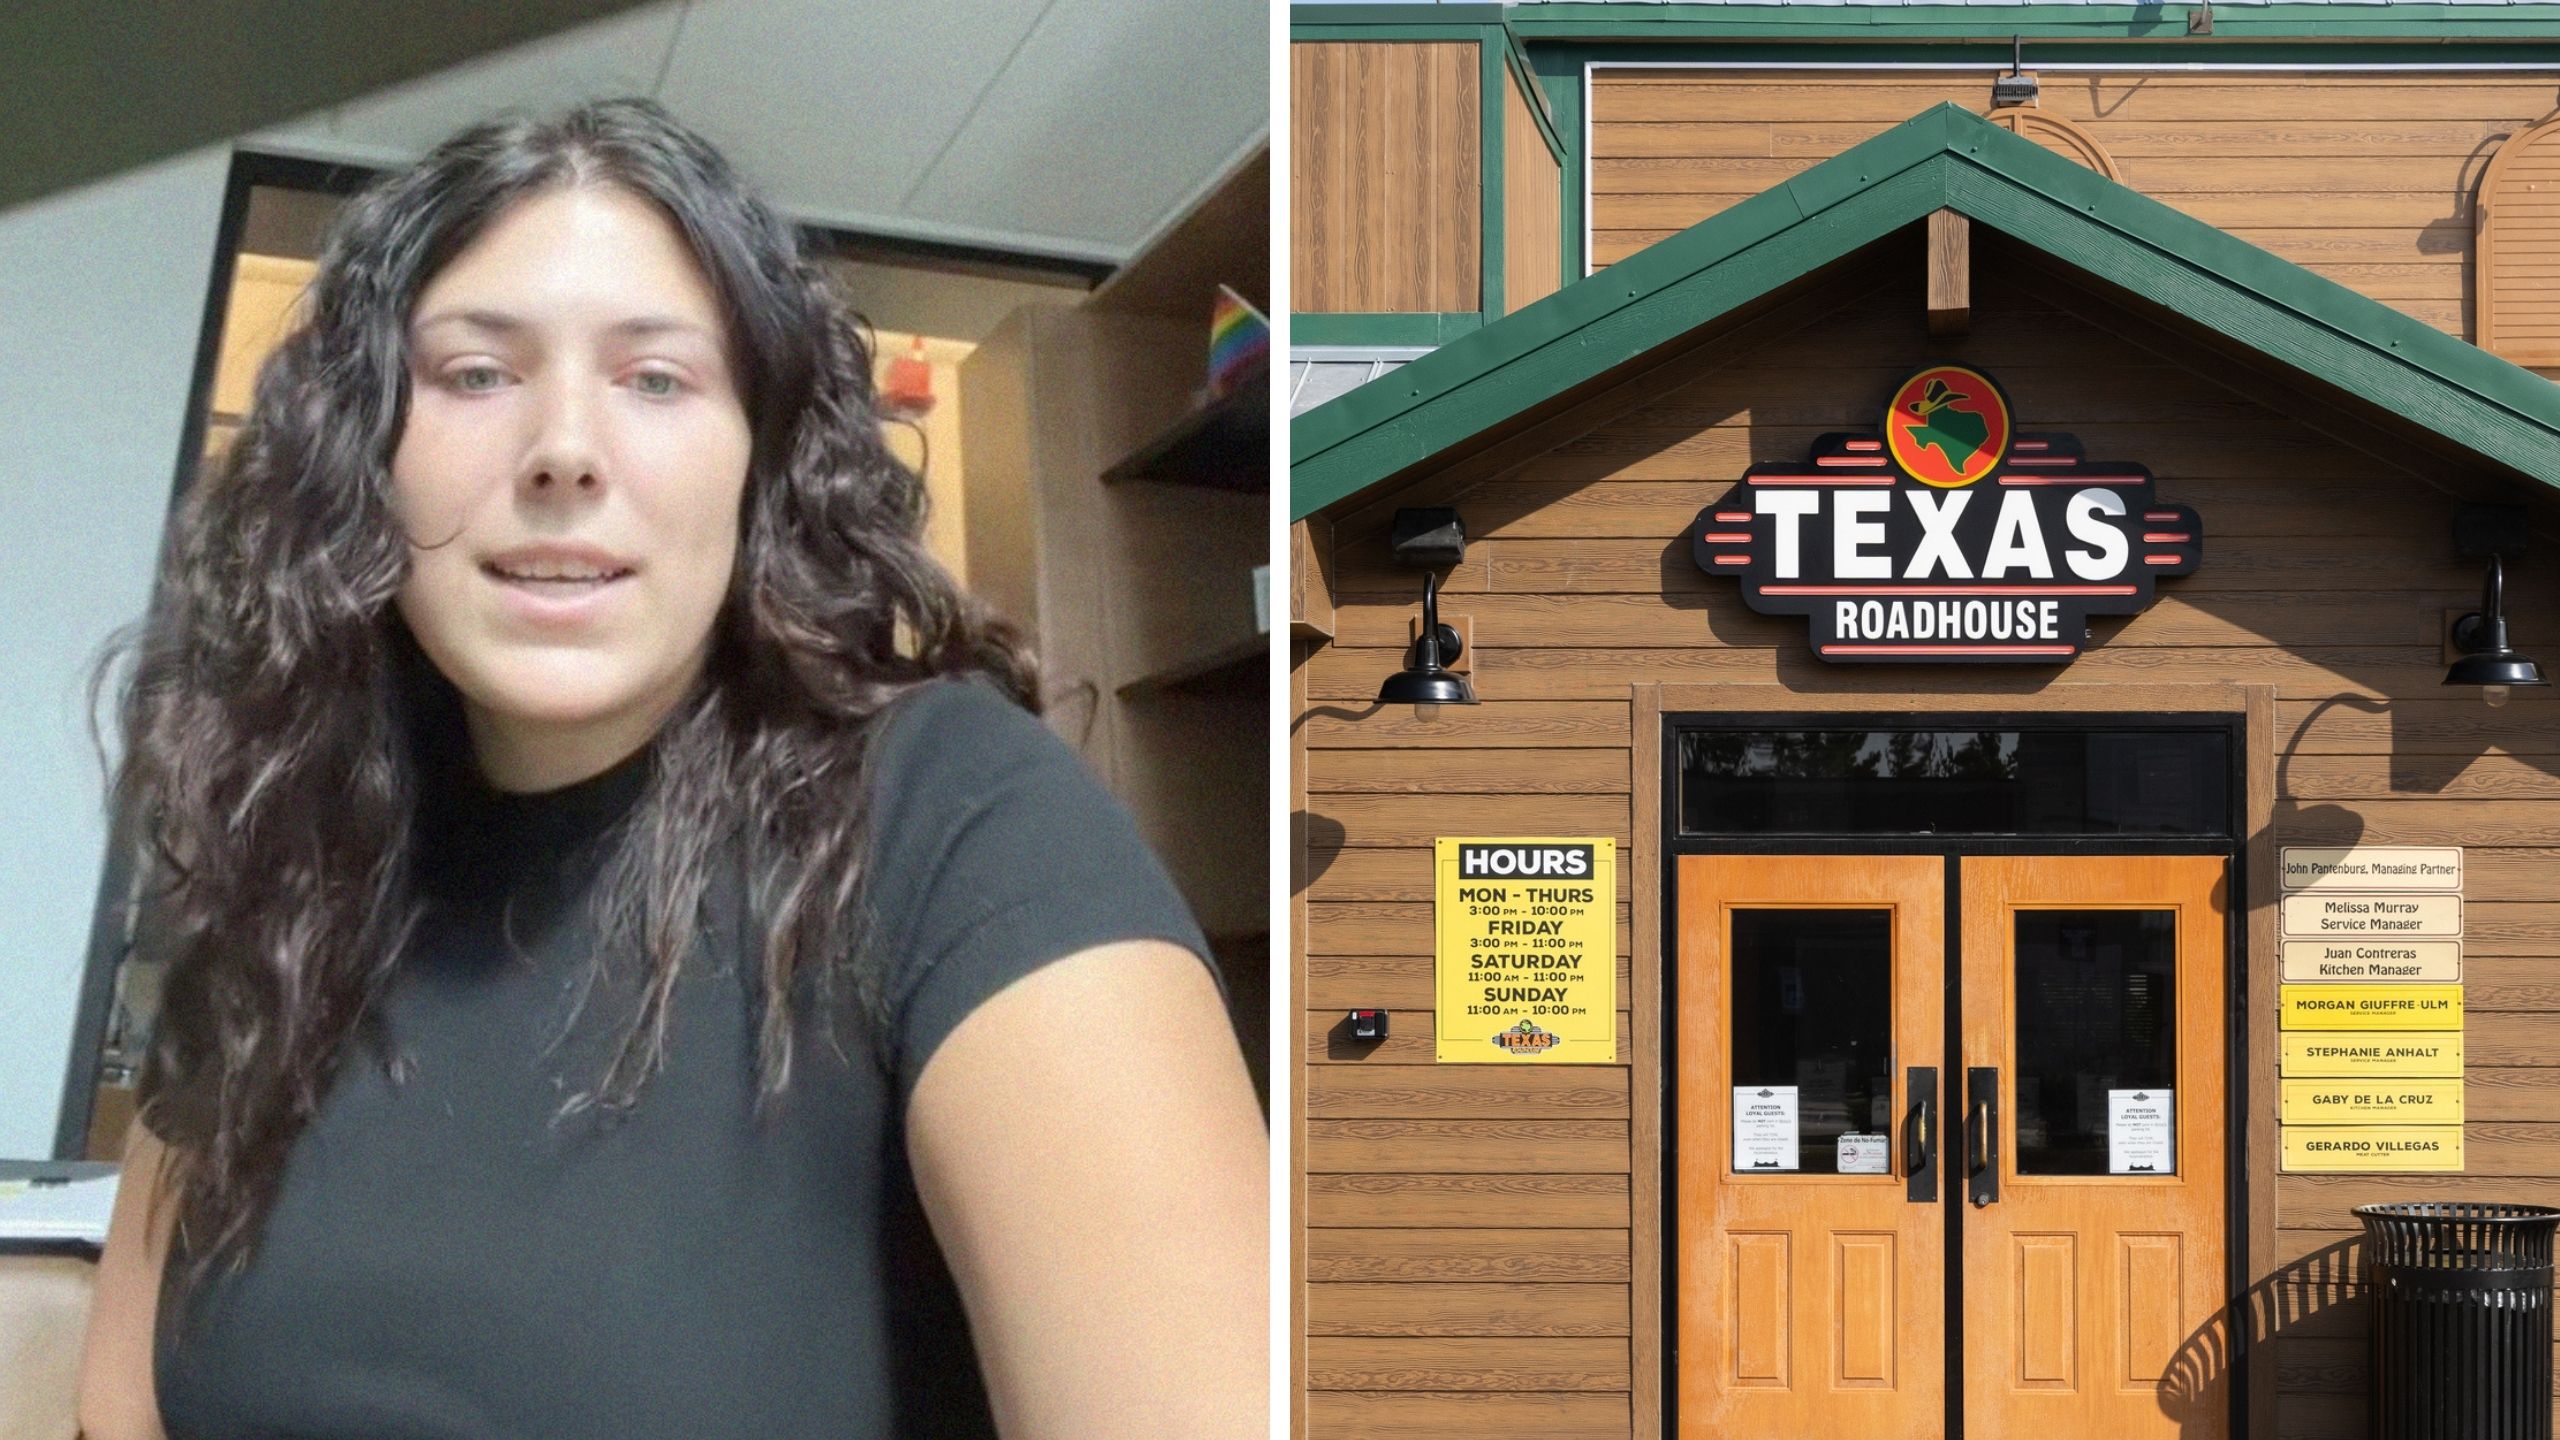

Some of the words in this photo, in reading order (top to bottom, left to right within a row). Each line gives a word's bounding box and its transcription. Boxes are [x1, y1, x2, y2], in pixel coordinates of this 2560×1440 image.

[1755, 487, 2129, 581] TEXAS
[1836, 600, 2059, 639] ROADHOUSE
[1465, 849, 1587, 875] HOURS
[2286, 863, 2308, 874] John
[2372, 864, 2417, 875] Managing
[2420, 864, 2455, 875] Partner
[1459, 888, 1507, 903] MON
[1526, 888, 1594, 903] THURS
[1469, 906, 1500, 916] 3:00
[1531, 906, 1568, 916] 10:00
[2325, 902, 2369, 913] Melissa
[2374, 902, 2419, 914] Murray
[1488, 920, 1564, 935] FRIDAY
[2321, 919, 2366, 930] Service
[2370, 919, 2423, 930] Manager
[1470, 938, 1500, 948] 3:00
[1532, 938, 1566, 948] 11:00
[2324, 947, 2352, 959] Juan
[2356, 947, 2417, 959] Contreras
[1471, 954, 1582, 969] SATURDAY
[2319, 964, 2364, 975] Kitchen
[2369, 964, 2422, 975] Manager
[1468, 972, 1501, 982] 11:00
[1533, 972, 1567, 982] 11:00
[1484, 988, 1568, 1002] SUNDAY
[1467, 1005, 1500, 1015] 11:00
[1532, 1005, 1569, 1015] 10:00
[2296, 1000, 2355, 1010] MORGAN
[1501, 1034, 1551, 1047] TEXAS
[2307, 1047, 2380, 1057] STEPHANIE
[2386, 1047, 2439, 1057] ANHALT
[2312, 1095, 2349, 1104] GABY
[2354, 1095, 2371, 1104] DE
[2376, 1095, 2394, 1104] LA
[2399, 1095, 2433, 1104] CRUZ
[2306, 1142, 2371, 1151] GERARDO
[2376, 1142, 2439, 1151] VILLEGAS
